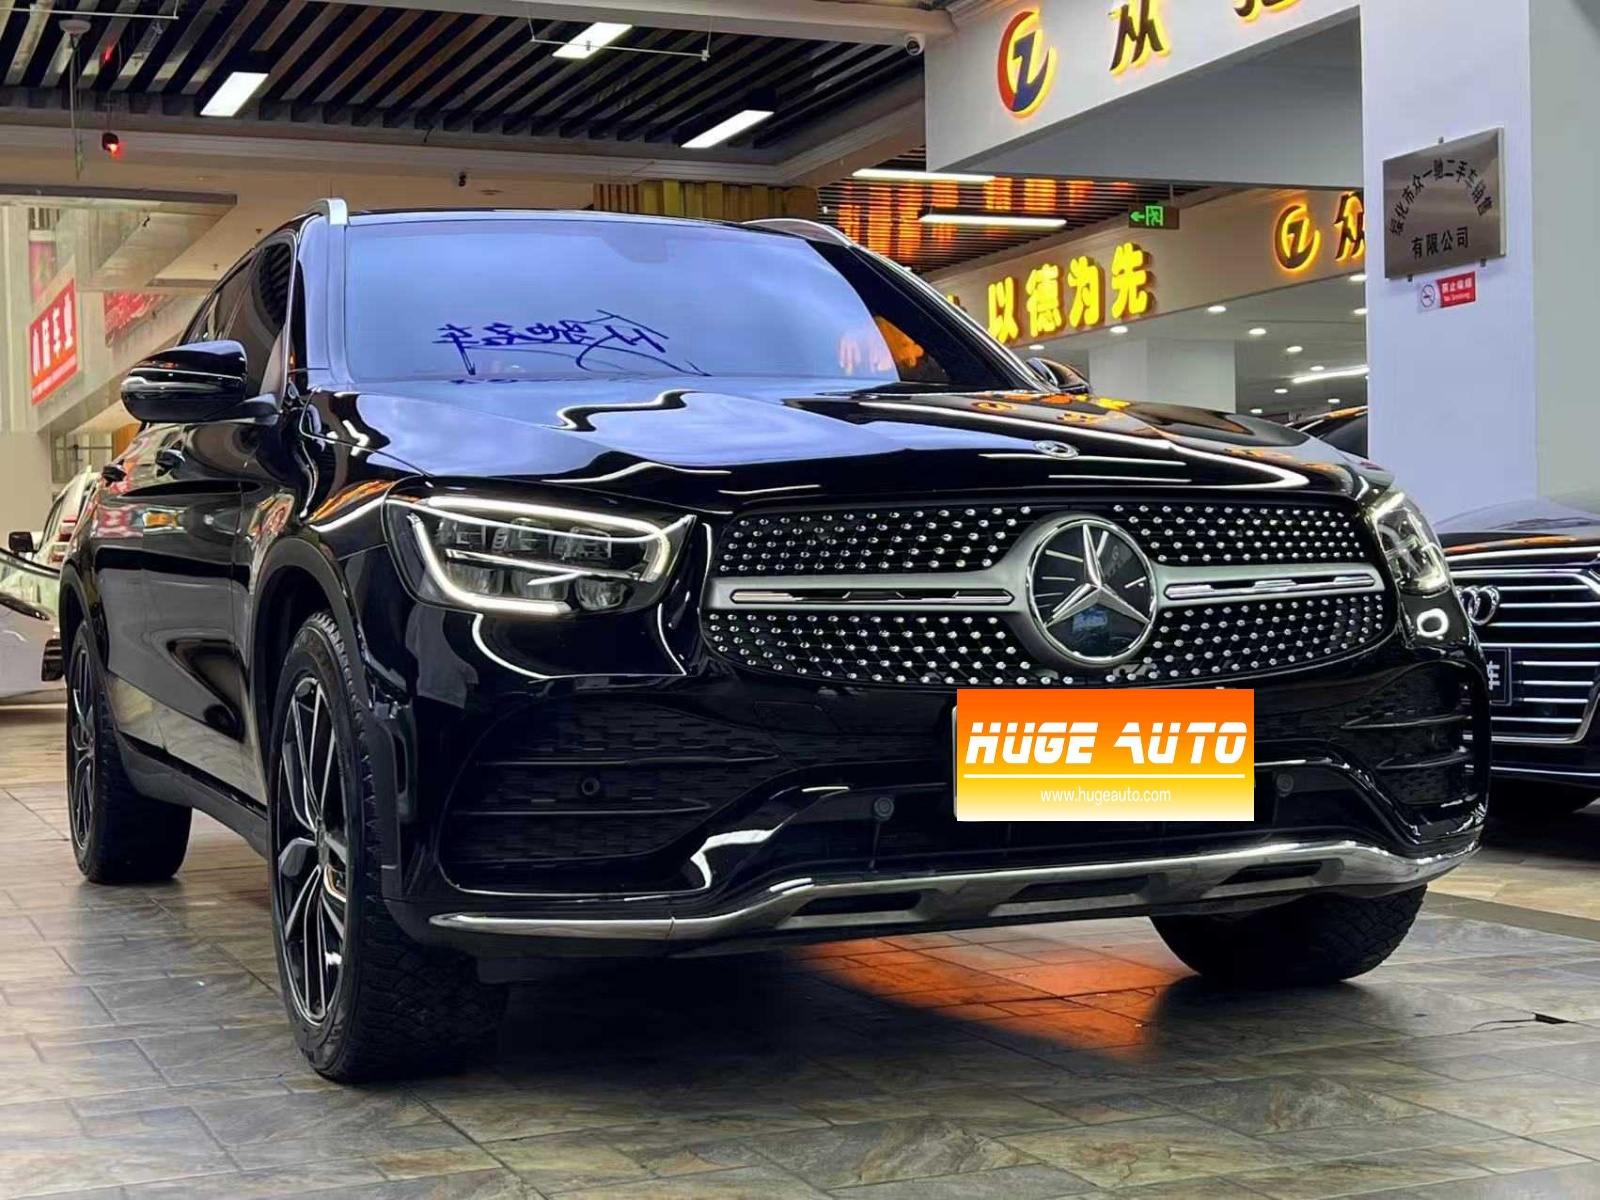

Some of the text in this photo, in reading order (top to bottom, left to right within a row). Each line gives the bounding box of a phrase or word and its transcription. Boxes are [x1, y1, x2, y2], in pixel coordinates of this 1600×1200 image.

[1411, 226, 1469, 260] 有限公司
[987, 242, 1151, 344] 以德为先
